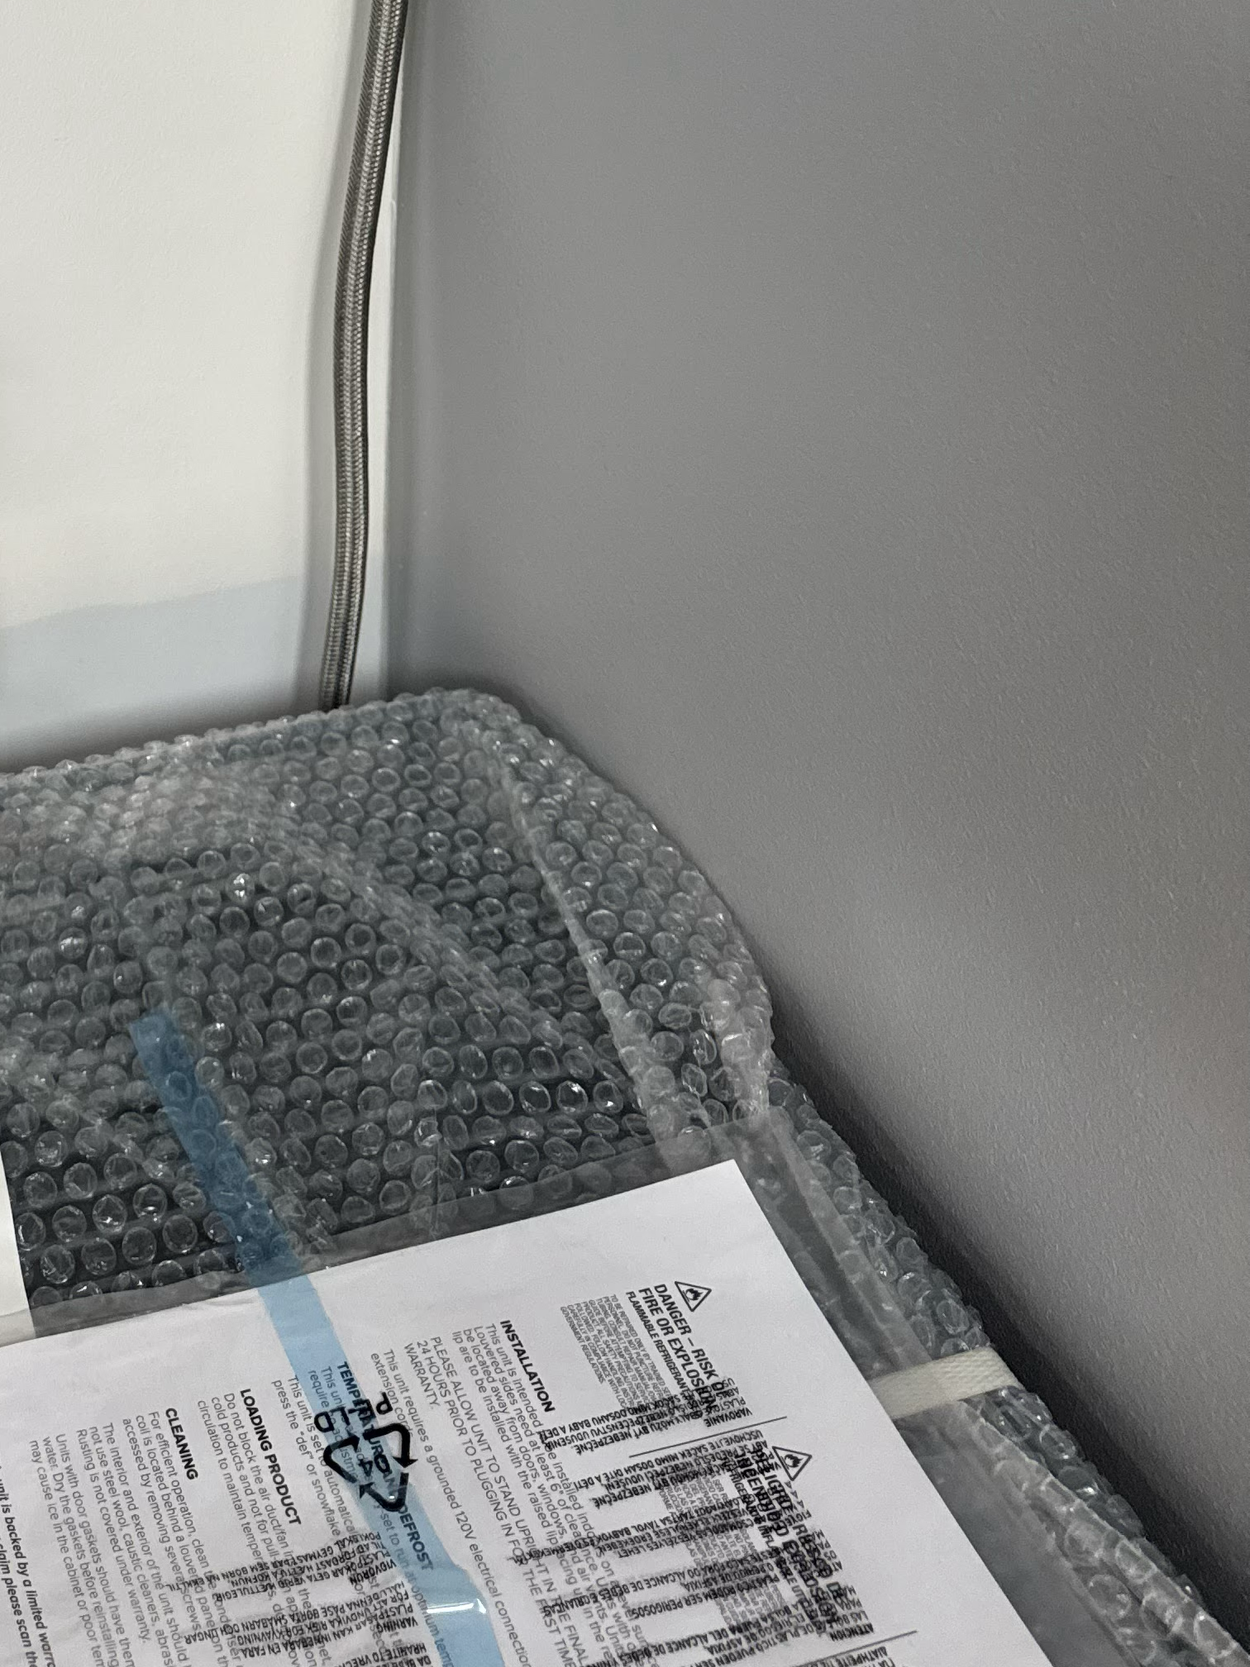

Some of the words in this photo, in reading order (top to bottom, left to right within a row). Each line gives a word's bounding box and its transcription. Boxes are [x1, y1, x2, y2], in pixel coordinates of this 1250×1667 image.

[637, 1286, 665, 1316] FIRE
[654, 1316, 676, 1335] OR
[461, 1327, 479, 1343] be
[624, 1290, 661, 1339] FLAMMABLE
[652, 1338, 692, 1393] REFRIGERANT
[652, 1283, 693, 1336] DANGER
[689, 1347, 719, 1379] RISK
[380, 1349, 401, 1372] This
[415, 1339, 432, 1355] 24
[428, 1335, 458, 1378] PLEASE
[473, 1324, 507, 1374] Louvered
[401, 1342, 441, 1409] WARRANTY.
[422, 1355, 452, 1398] HOURS
[469, 1343, 498, 1384] located
[497, 1318, 557, 1413] INSTALLATION
[391, 1372, 411, 1394] unit
[497, 1375, 522, 1406] sides
[222, 1391, 240, 1410] Do
[448, 1379, 479, 1422] ALLOW
[486, 1385, 511, 1415] away
[147, 1410, 165, 1430] For
[229, 1410, 248, 1431] not
[398, 1394, 432, 1442] requires
[442, 1399, 469, 1436] PRIOR
[504, 1415, 527, 1444] from
[512, 1406, 537, 1437] need
[567, 1418, 590, 1431] BABY
[590, 1407, 626, 1425] DOSAHU
[703, 1406, 752, 1427] VAROVANIE
[54, 1432, 75, 1462] Units
[101, 1421, 120, 1445] The
[164, 1406, 200, 1480] CLEANING
[237, 1430, 260, 1464] block
[422, 1443, 434, 1453] a
[460, 1438, 479, 1457] TO
[469, 1423, 493, 1454] UNIT
[527, 1438, 543, 1451] at
[109, 1445, 133, 1486] interior
[154, 1431, 181, 1477] efficient
[239, 1387, 274, 1452] LOADING
[263, 1453, 302, 1526] PRODUCT
[483, 1455, 502, 1473] TO
[515, 1444, 546, 1482] doors,
[533, 1451, 558, 1482] least
[623, 1459, 653, 1476] DOSAH
[64, 1462, 83, 1488] with
[249, 1464, 268, 1485] the
[424, 1453, 463, 1510] grounded
[469, 1457, 508, 1521] PLUGGING
[0, 1502, 15, 1514] is
[71, 1488, 92, 1518] door
[122, 1487, 141, 1511] and
[168, 1478, 201, 1537] operation,
[257, 1485, 274, 1502] air
[492, 1474, 522, 1517] STAND
[555, 1498, 572, 1511] of
[262, 1502, 291, 1549] duct/fan
[534, 1483, 572, 1537] windows,
[4, 1514, 28, 1560] backed
[78, 1518, 105, 1564] gaskets
[130, 1512, 156, 1556] exterior
[452, 1510, 477, 1542] 120V
[498, 1522, 516, 1538] IN
[145, 1557, 161, 1571] of
[190, 1537, 212, 1568] clean
[15, 1560, 33, 1578] by
[22, 1578, 33, 1588] a
[94, 1563, 117, 1603] should
[149, 1570, 167, 1591] the
[466, 1542, 502, 1598] electrical
[643, 1568, 686, 1590] ALCANCE
[629, 1580, 643, 1592] DE
[682, 1592, 702, 1605] SER
[2, 1574, 27, 1617] please
[16, 1617, 33, 1648] scan
[25, 1588, 48, 1630] limited
[156, 1591, 175, 1615] unit
[106, 1604, 127, 1636] have
[709, 1626, 729, 1641] DEL
[164, 1615, 190, 1662] should
[665, 1631, 709, 1654] ALCANCE
